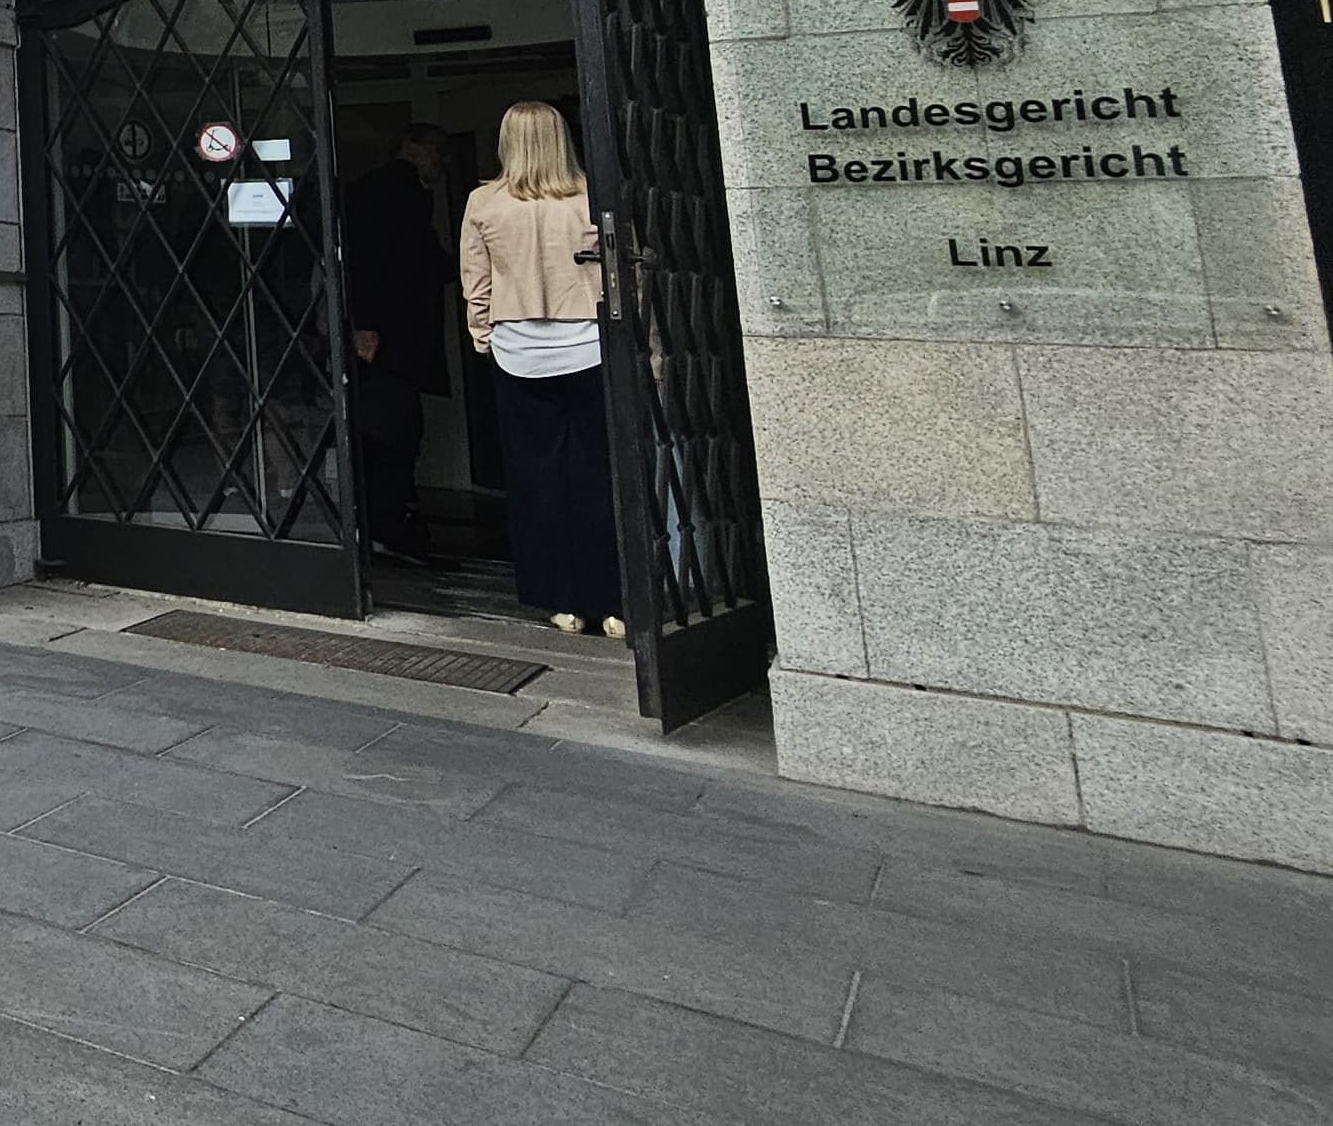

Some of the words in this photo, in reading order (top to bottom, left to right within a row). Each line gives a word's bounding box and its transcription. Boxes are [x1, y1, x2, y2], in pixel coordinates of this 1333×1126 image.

[800, 86, 1182, 132] Landesgericht
[807, 144, 1189, 188] Bezirksgericht
[947, 238, 1053, 269] Linz
